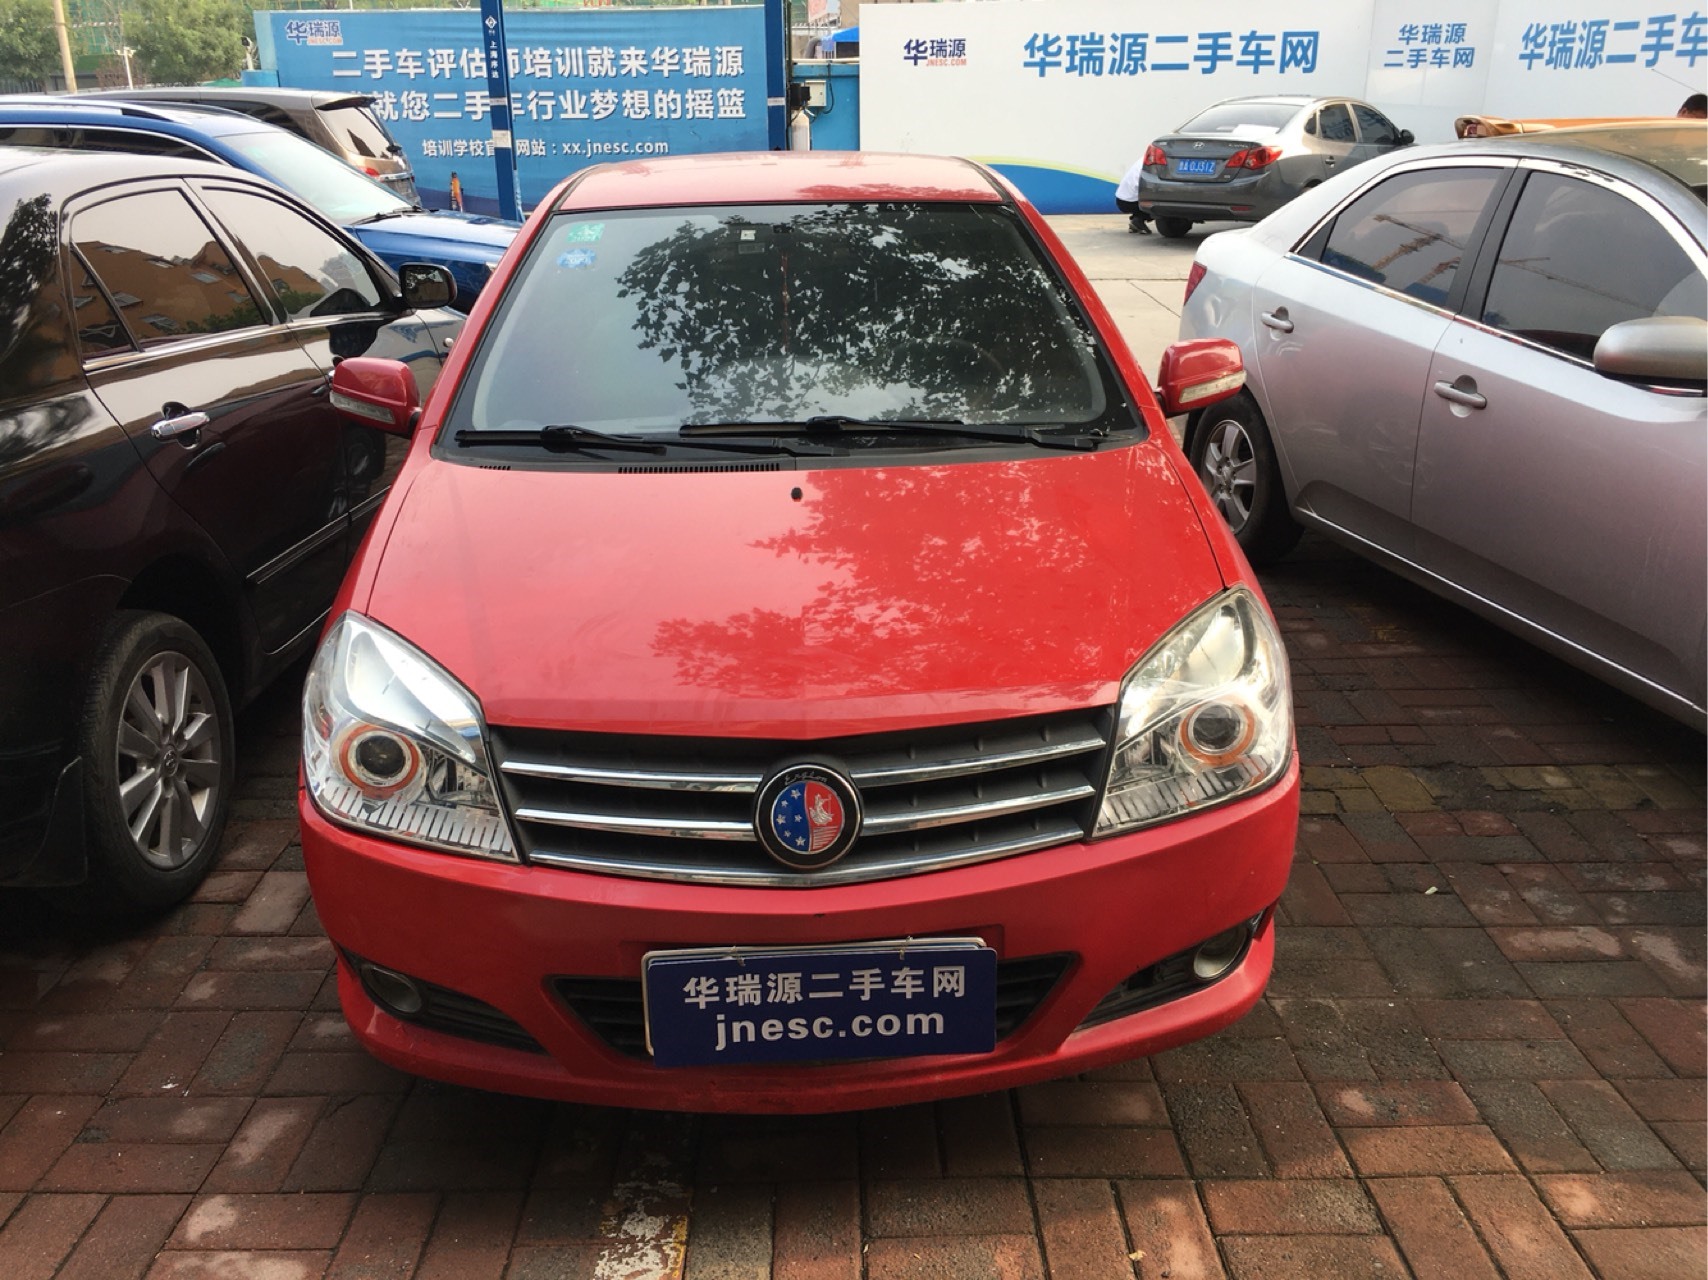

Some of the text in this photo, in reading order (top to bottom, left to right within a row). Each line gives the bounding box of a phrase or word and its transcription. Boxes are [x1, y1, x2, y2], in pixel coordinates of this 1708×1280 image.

[286, 21, 341, 44] 华瑞源
[1398, 23, 1467, 45] 华瑞源
[1518, 11, 1708, 70] 华瑞源二手车
[903, 38, 966, 66] 华瑞源
[1023, 30, 1319, 77] 华瑞源二手车网
[1384, 47, 1475, 69] 二手车网
[683, 965, 965, 1009] 华瑞源二手车网
[715, 1011, 944, 1051] jnesc.com
